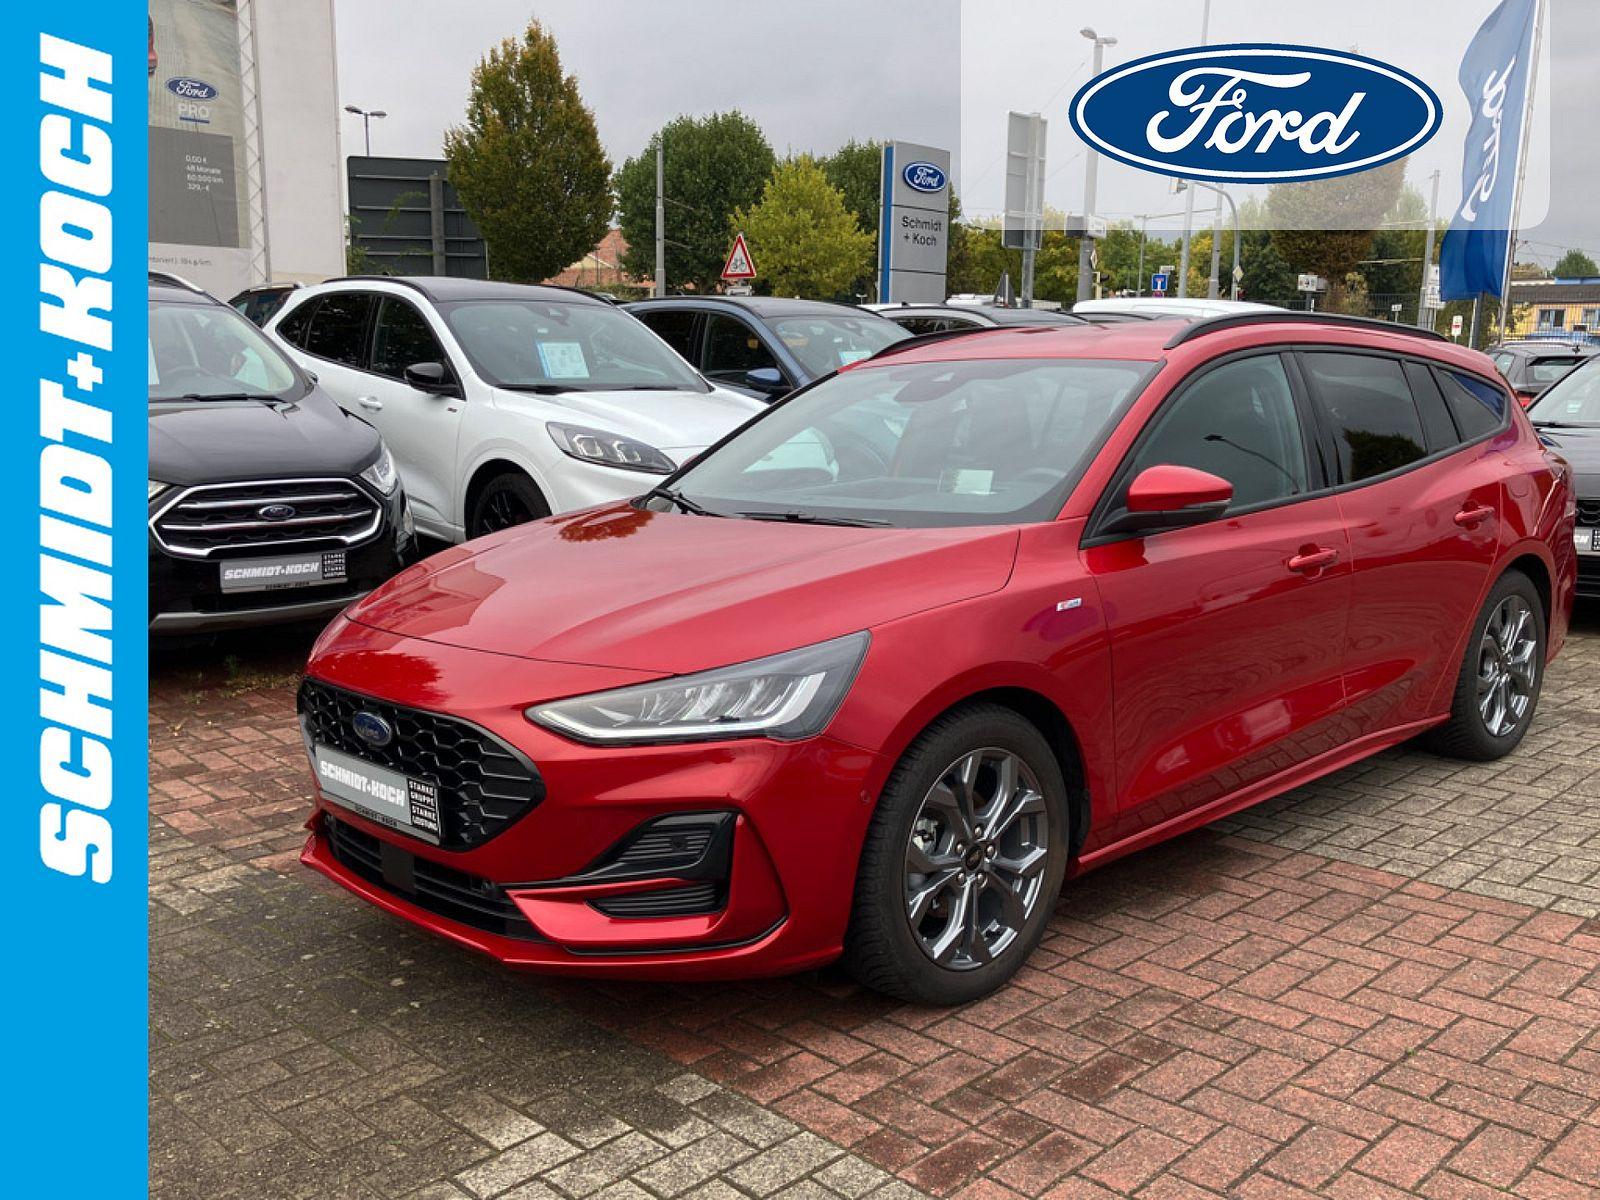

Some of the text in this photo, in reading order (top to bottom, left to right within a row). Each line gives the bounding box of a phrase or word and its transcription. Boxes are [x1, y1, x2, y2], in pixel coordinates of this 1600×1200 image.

[176, 80, 209, 97] Ford
[178, 103, 210, 118] PRO
[913, 166, 940, 187] Ford
[902, 215, 942, 231] Schmidt
[904, 232, 937, 246] + Koch
[321, 760, 405, 807] SCHMIDT+KOCH
